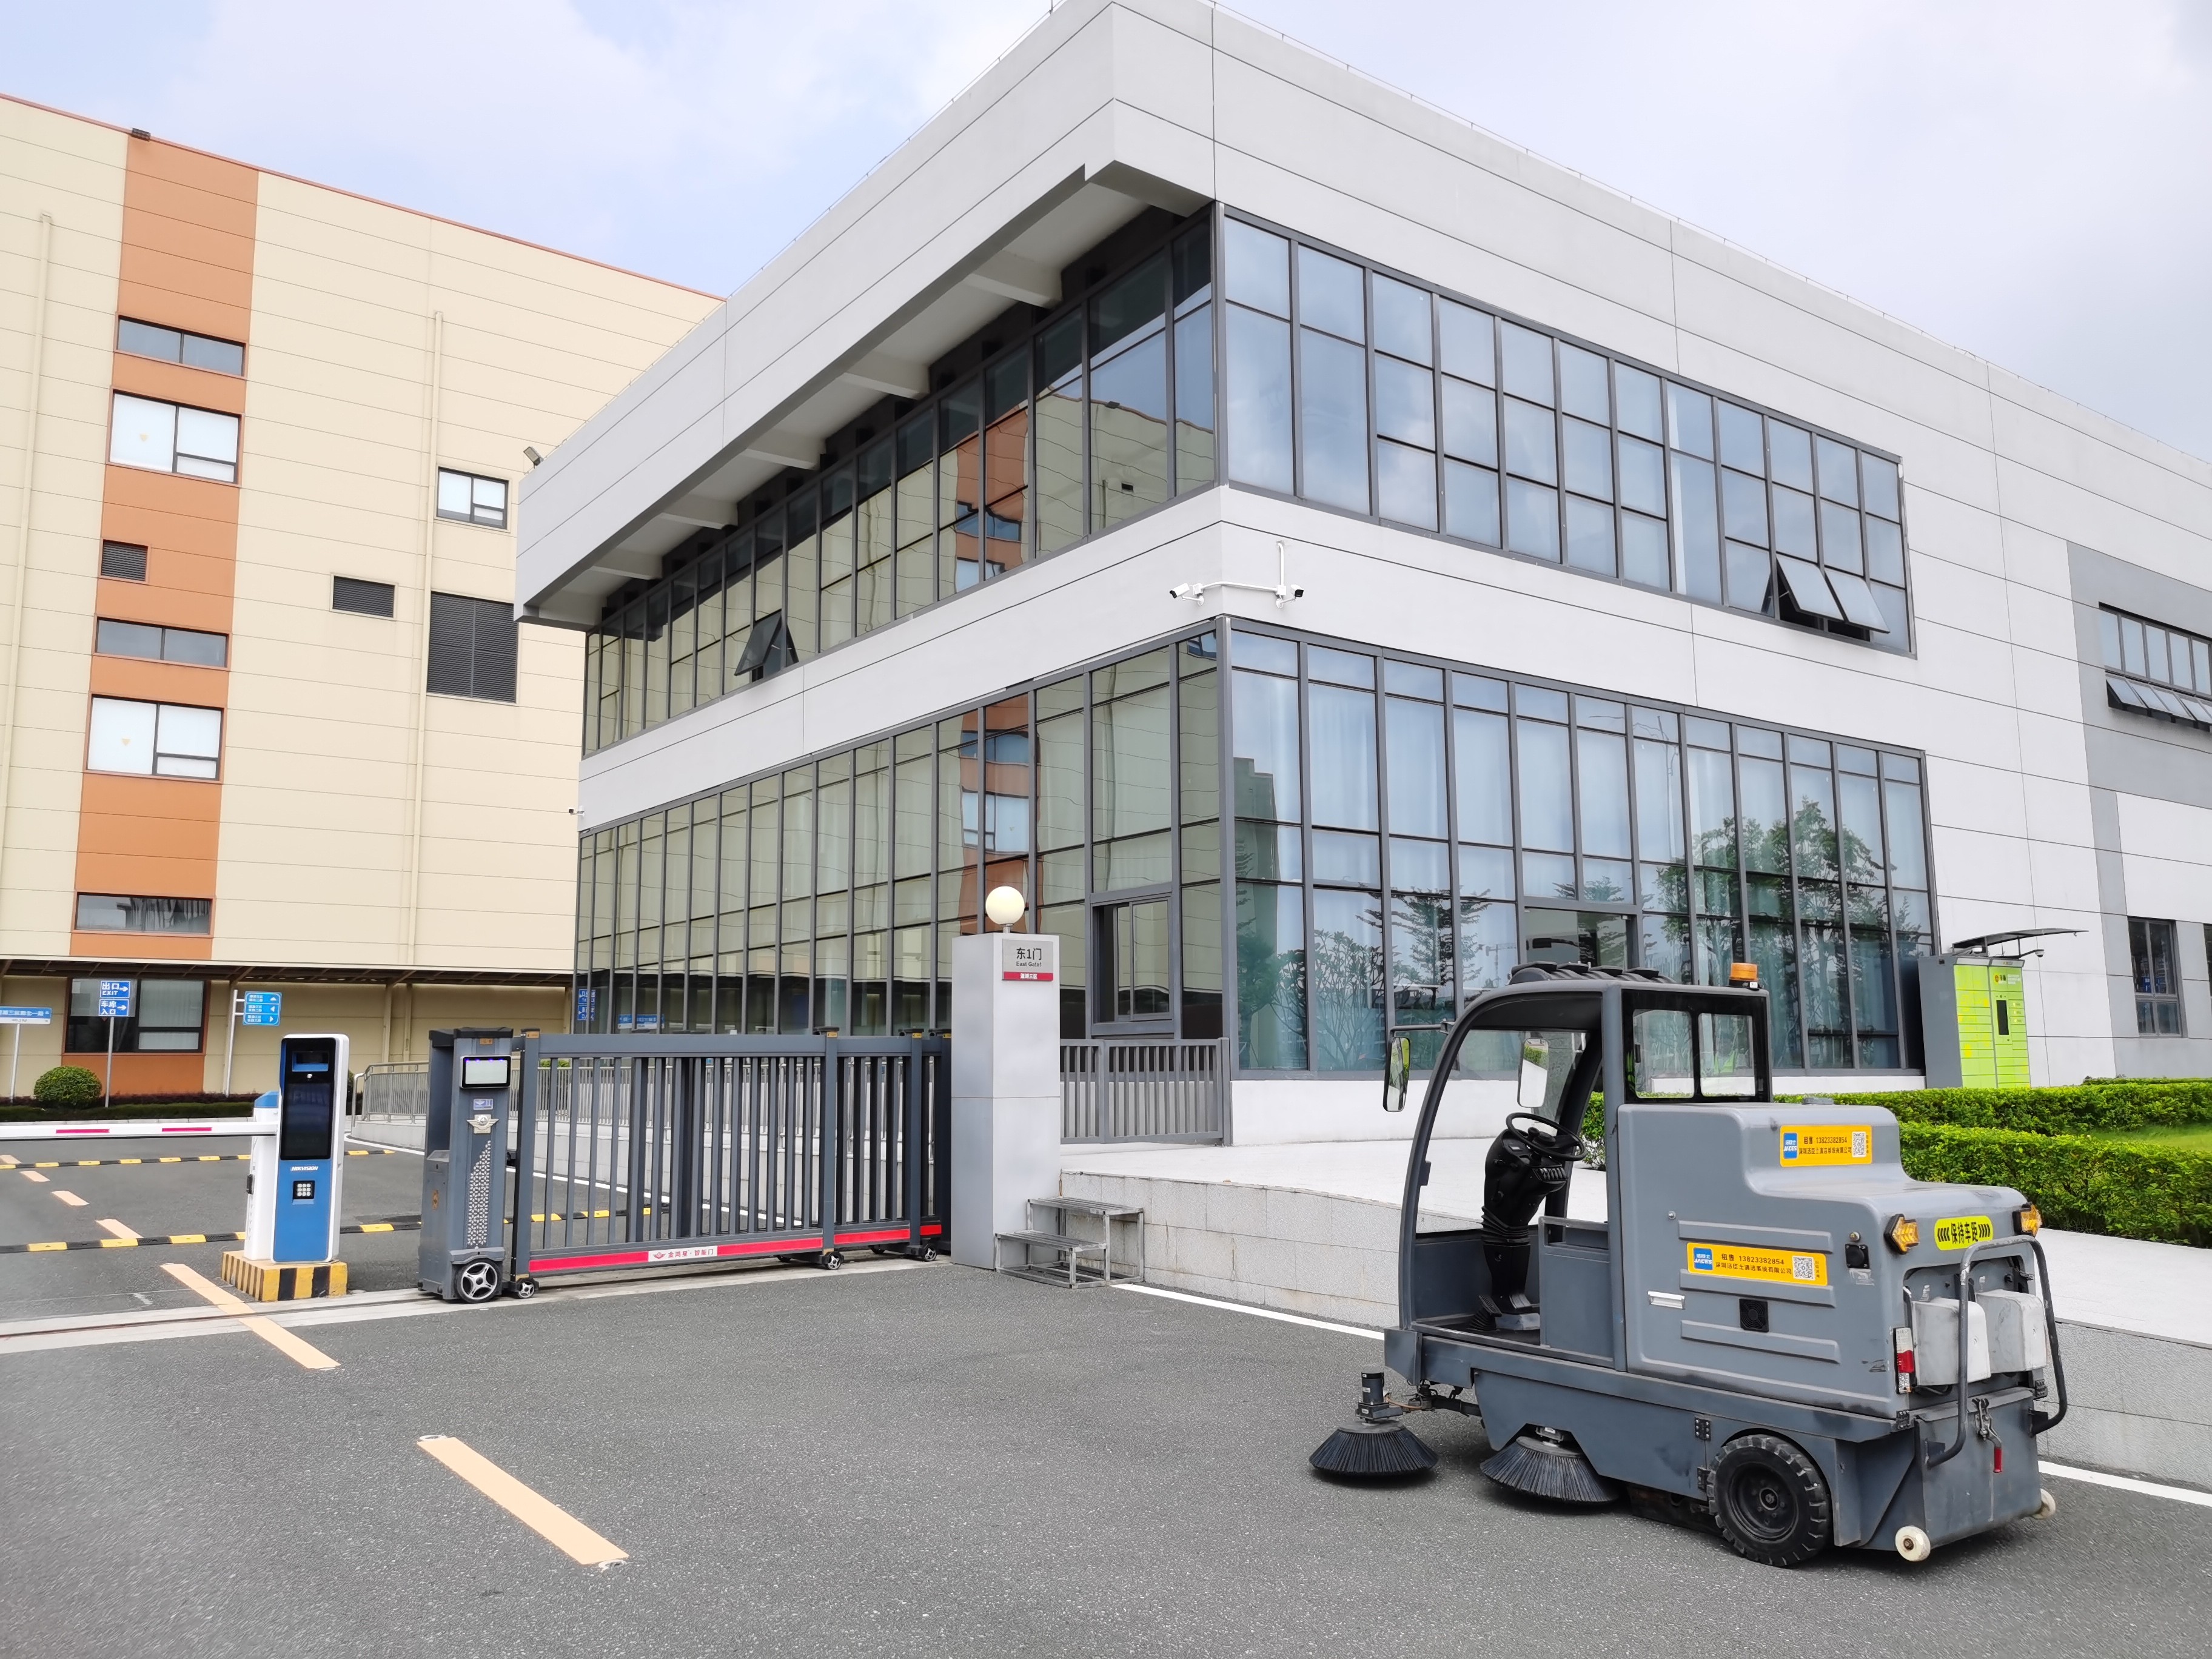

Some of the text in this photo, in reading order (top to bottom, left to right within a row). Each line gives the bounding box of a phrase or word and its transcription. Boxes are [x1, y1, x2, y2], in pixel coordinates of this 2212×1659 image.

[1016, 947, 1042, 960] 东1门
[1951, 1221, 1978, 1244] 保持车距
[1738, 1255, 1785, 1265] 13823382854
